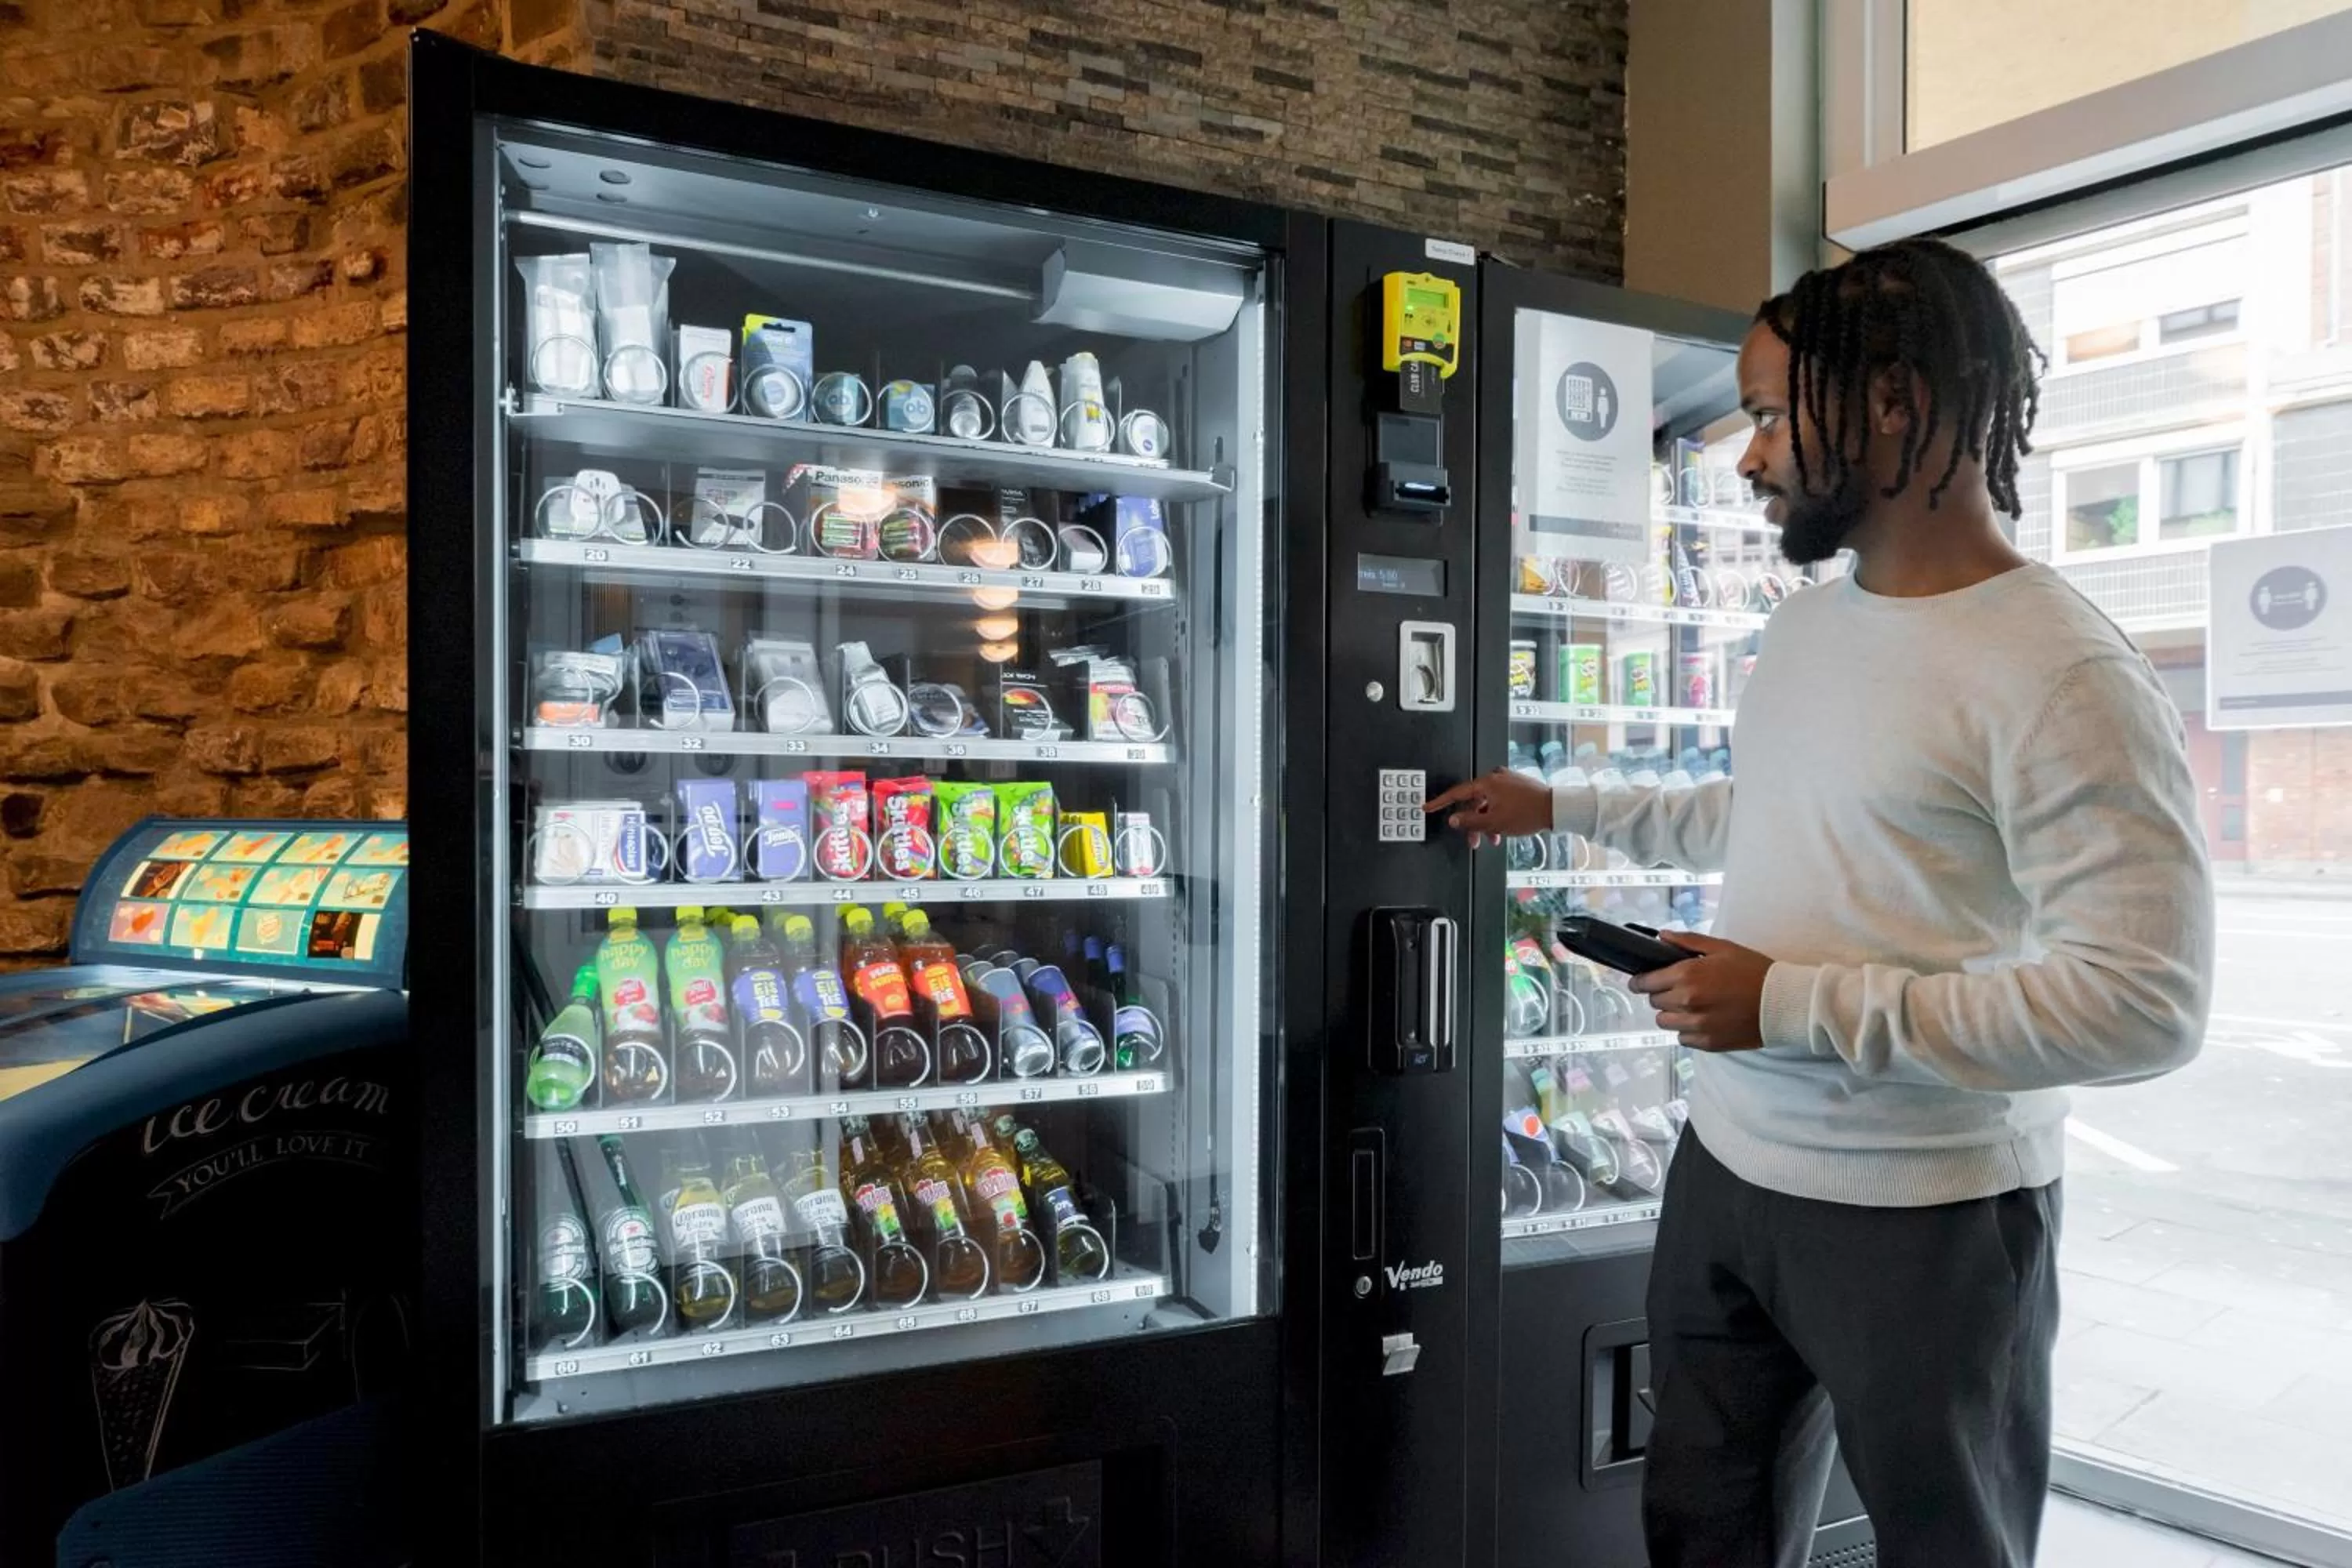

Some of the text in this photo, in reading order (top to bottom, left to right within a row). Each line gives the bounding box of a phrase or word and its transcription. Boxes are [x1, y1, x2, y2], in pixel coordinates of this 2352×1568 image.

[586, 551, 607, 561] 20
[732, 560, 751, 568] 22
[836, 565, 856, 575] 24
[899, 570, 916, 579] 25
[963, 573, 980, 583] 26
[1025, 577, 1044, 586] 27
[571, 737, 590, 746] 30
[682, 739, 702, 749] 32
[788, 741, 805, 750] 33
[870, 744, 888, 753] 34
[948, 746, 965, 756] 36
[1039, 748, 1057, 757] 38
[763, 891, 782, 901] 43
[833, 891, 852, 900] 44
[902, 889, 918, 898] 45
[964, 888, 982, 898] 46
[1025, 887, 1043, 896] 47
[597, 892, 617, 903] 40
[598, 943, 648, 962] happy
[671, 942, 717, 961] happy
[610, 956, 640, 970] day
[681, 956, 710, 969] day
[959, 1094, 977, 1104] 56
[1024, 1090, 1040, 1099] 57
[830, 1103, 848, 1113] 54
[899, 1099, 916, 1109] 55
[770, 1107, 789, 1117] 53
[705, 1112, 724, 1123] 52
[557, 1122, 576, 1133] 50
[621, 1119, 641, 1128] 51
[176, 1135, 371, 1194] YOU'LL LOVE IT
[675, 1208, 720, 1227] Corona
[1384, 1259, 1443, 1289] Vendo
[1021, 1301, 1038, 1312] 67
[959, 1310, 976, 1319] 66
[898, 1318, 916, 1328] 65
[835, 1327, 853, 1337] 64
[771, 1335, 789, 1345] 63
[704, 1344, 723, 1354] 62
[630, 1353, 650, 1364] 61
[557, 1363, 577, 1374] 60
